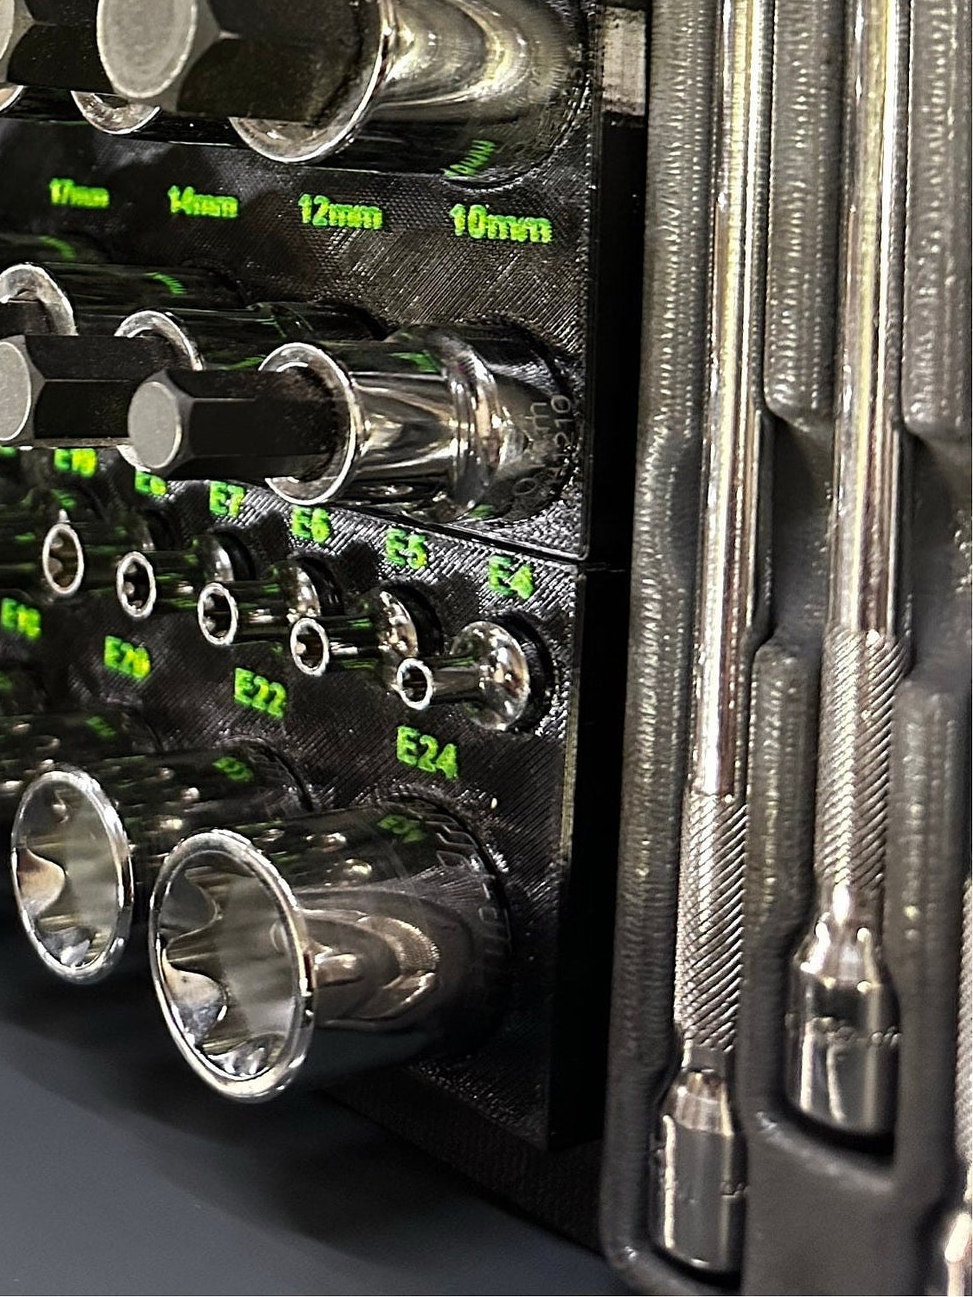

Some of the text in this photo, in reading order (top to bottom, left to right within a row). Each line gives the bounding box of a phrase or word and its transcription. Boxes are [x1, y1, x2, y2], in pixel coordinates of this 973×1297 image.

[167, 185, 239, 219] 14mm
[300, 195, 384, 230] 12mm
[452, 205, 552, 244] 10mm
[208, 481, 246, 518] E7
[290, 508, 331, 544] E6
[386, 528, 428, 570] E5
[488, 554, 534, 599] E4
[233, 668, 287, 720] E22
[395, 727, 458, 779] E24
